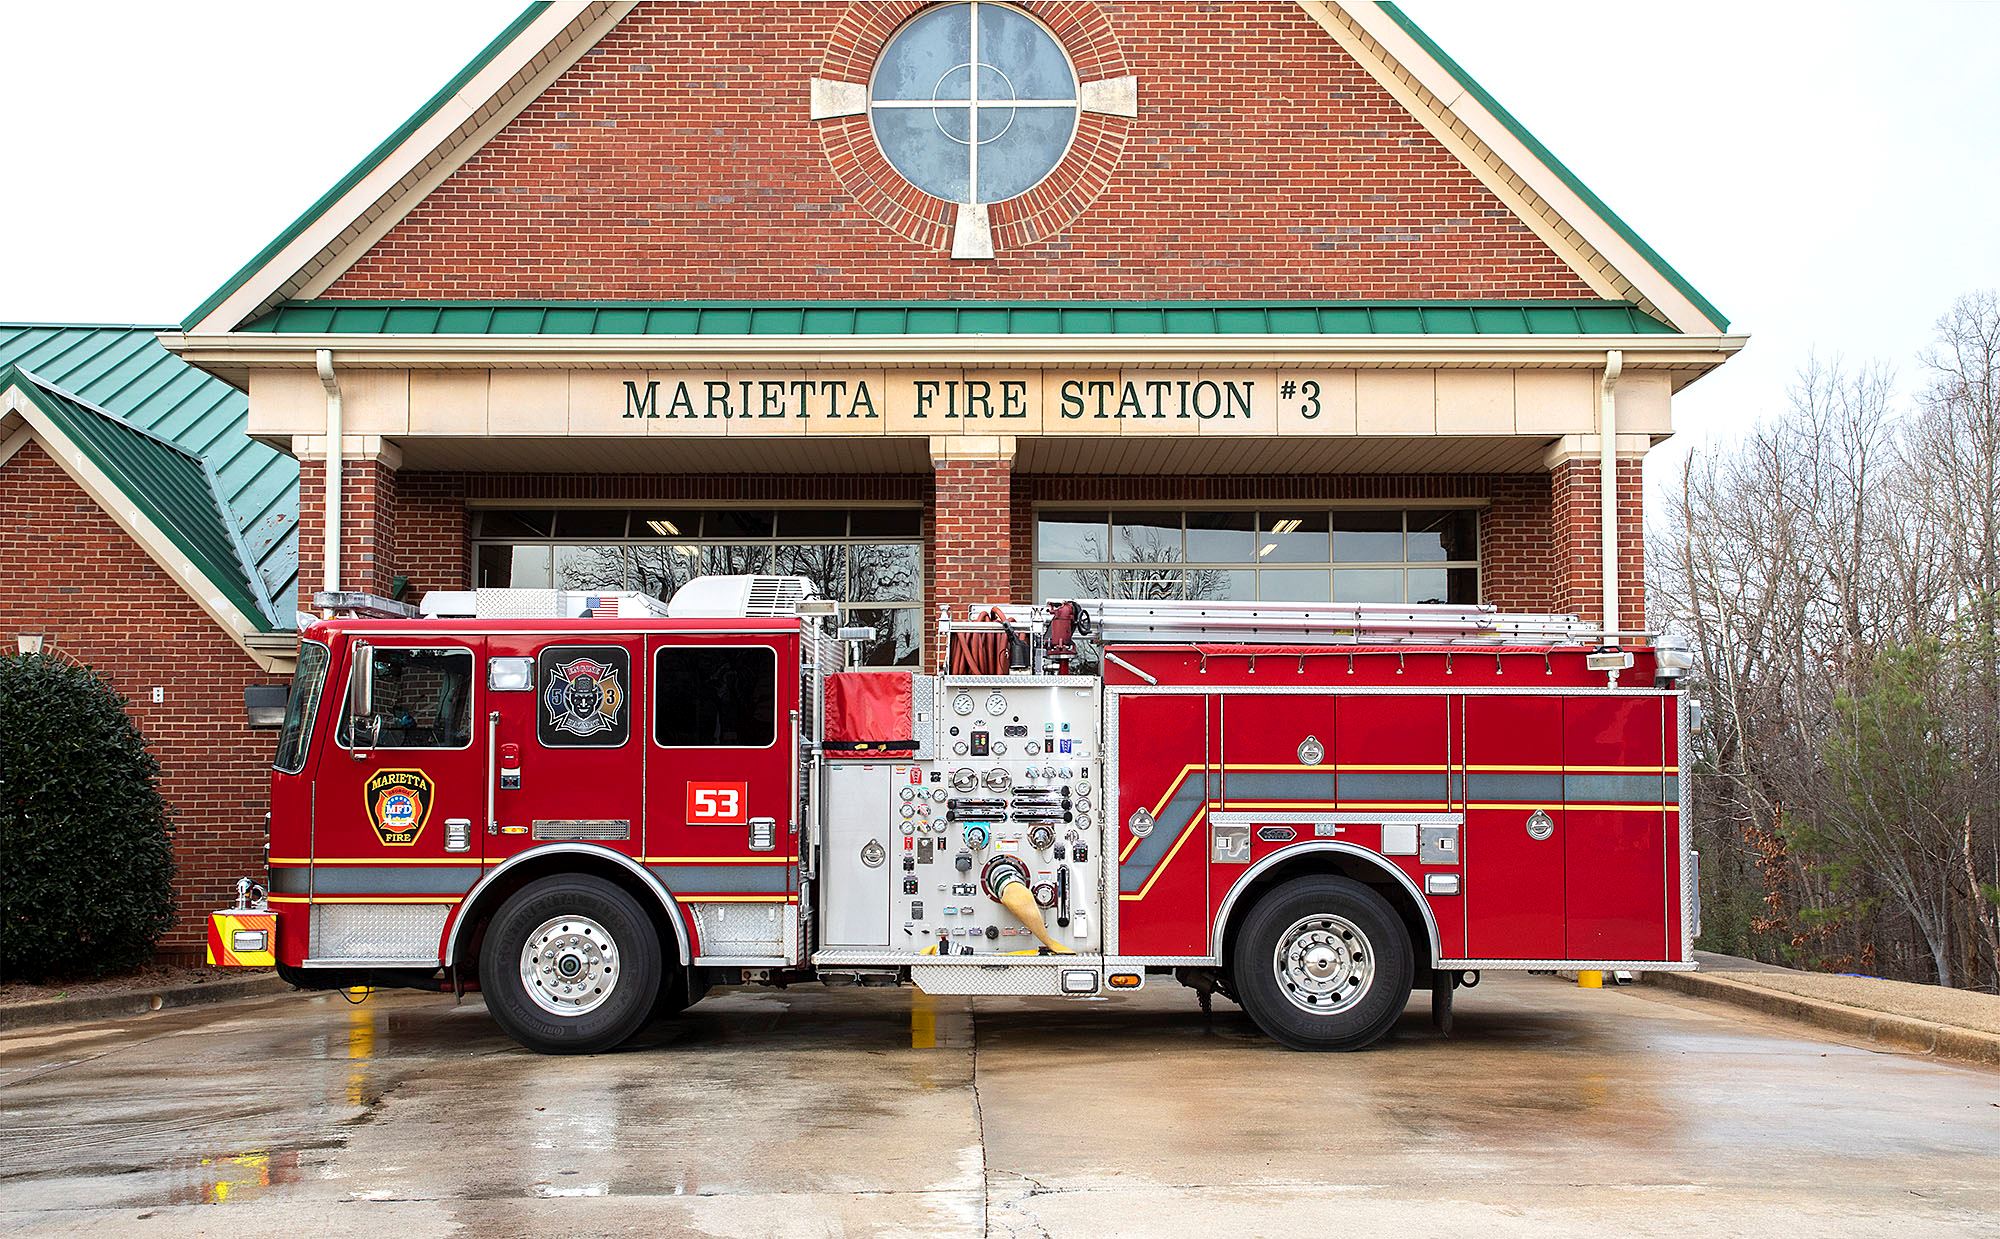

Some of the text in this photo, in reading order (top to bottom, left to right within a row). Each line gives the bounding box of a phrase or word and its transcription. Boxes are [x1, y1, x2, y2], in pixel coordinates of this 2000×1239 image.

[622, 379, 1321, 419] MARIETTA FIRE STATION #3
[551, 688, 563, 705] 5
[606, 688, 616, 705] 3
[371, 774, 427, 791] MARIETTA
[385, 805, 412, 815] MFD
[695, 789, 739, 817] 53
[385, 833, 411, 842] FIRE
